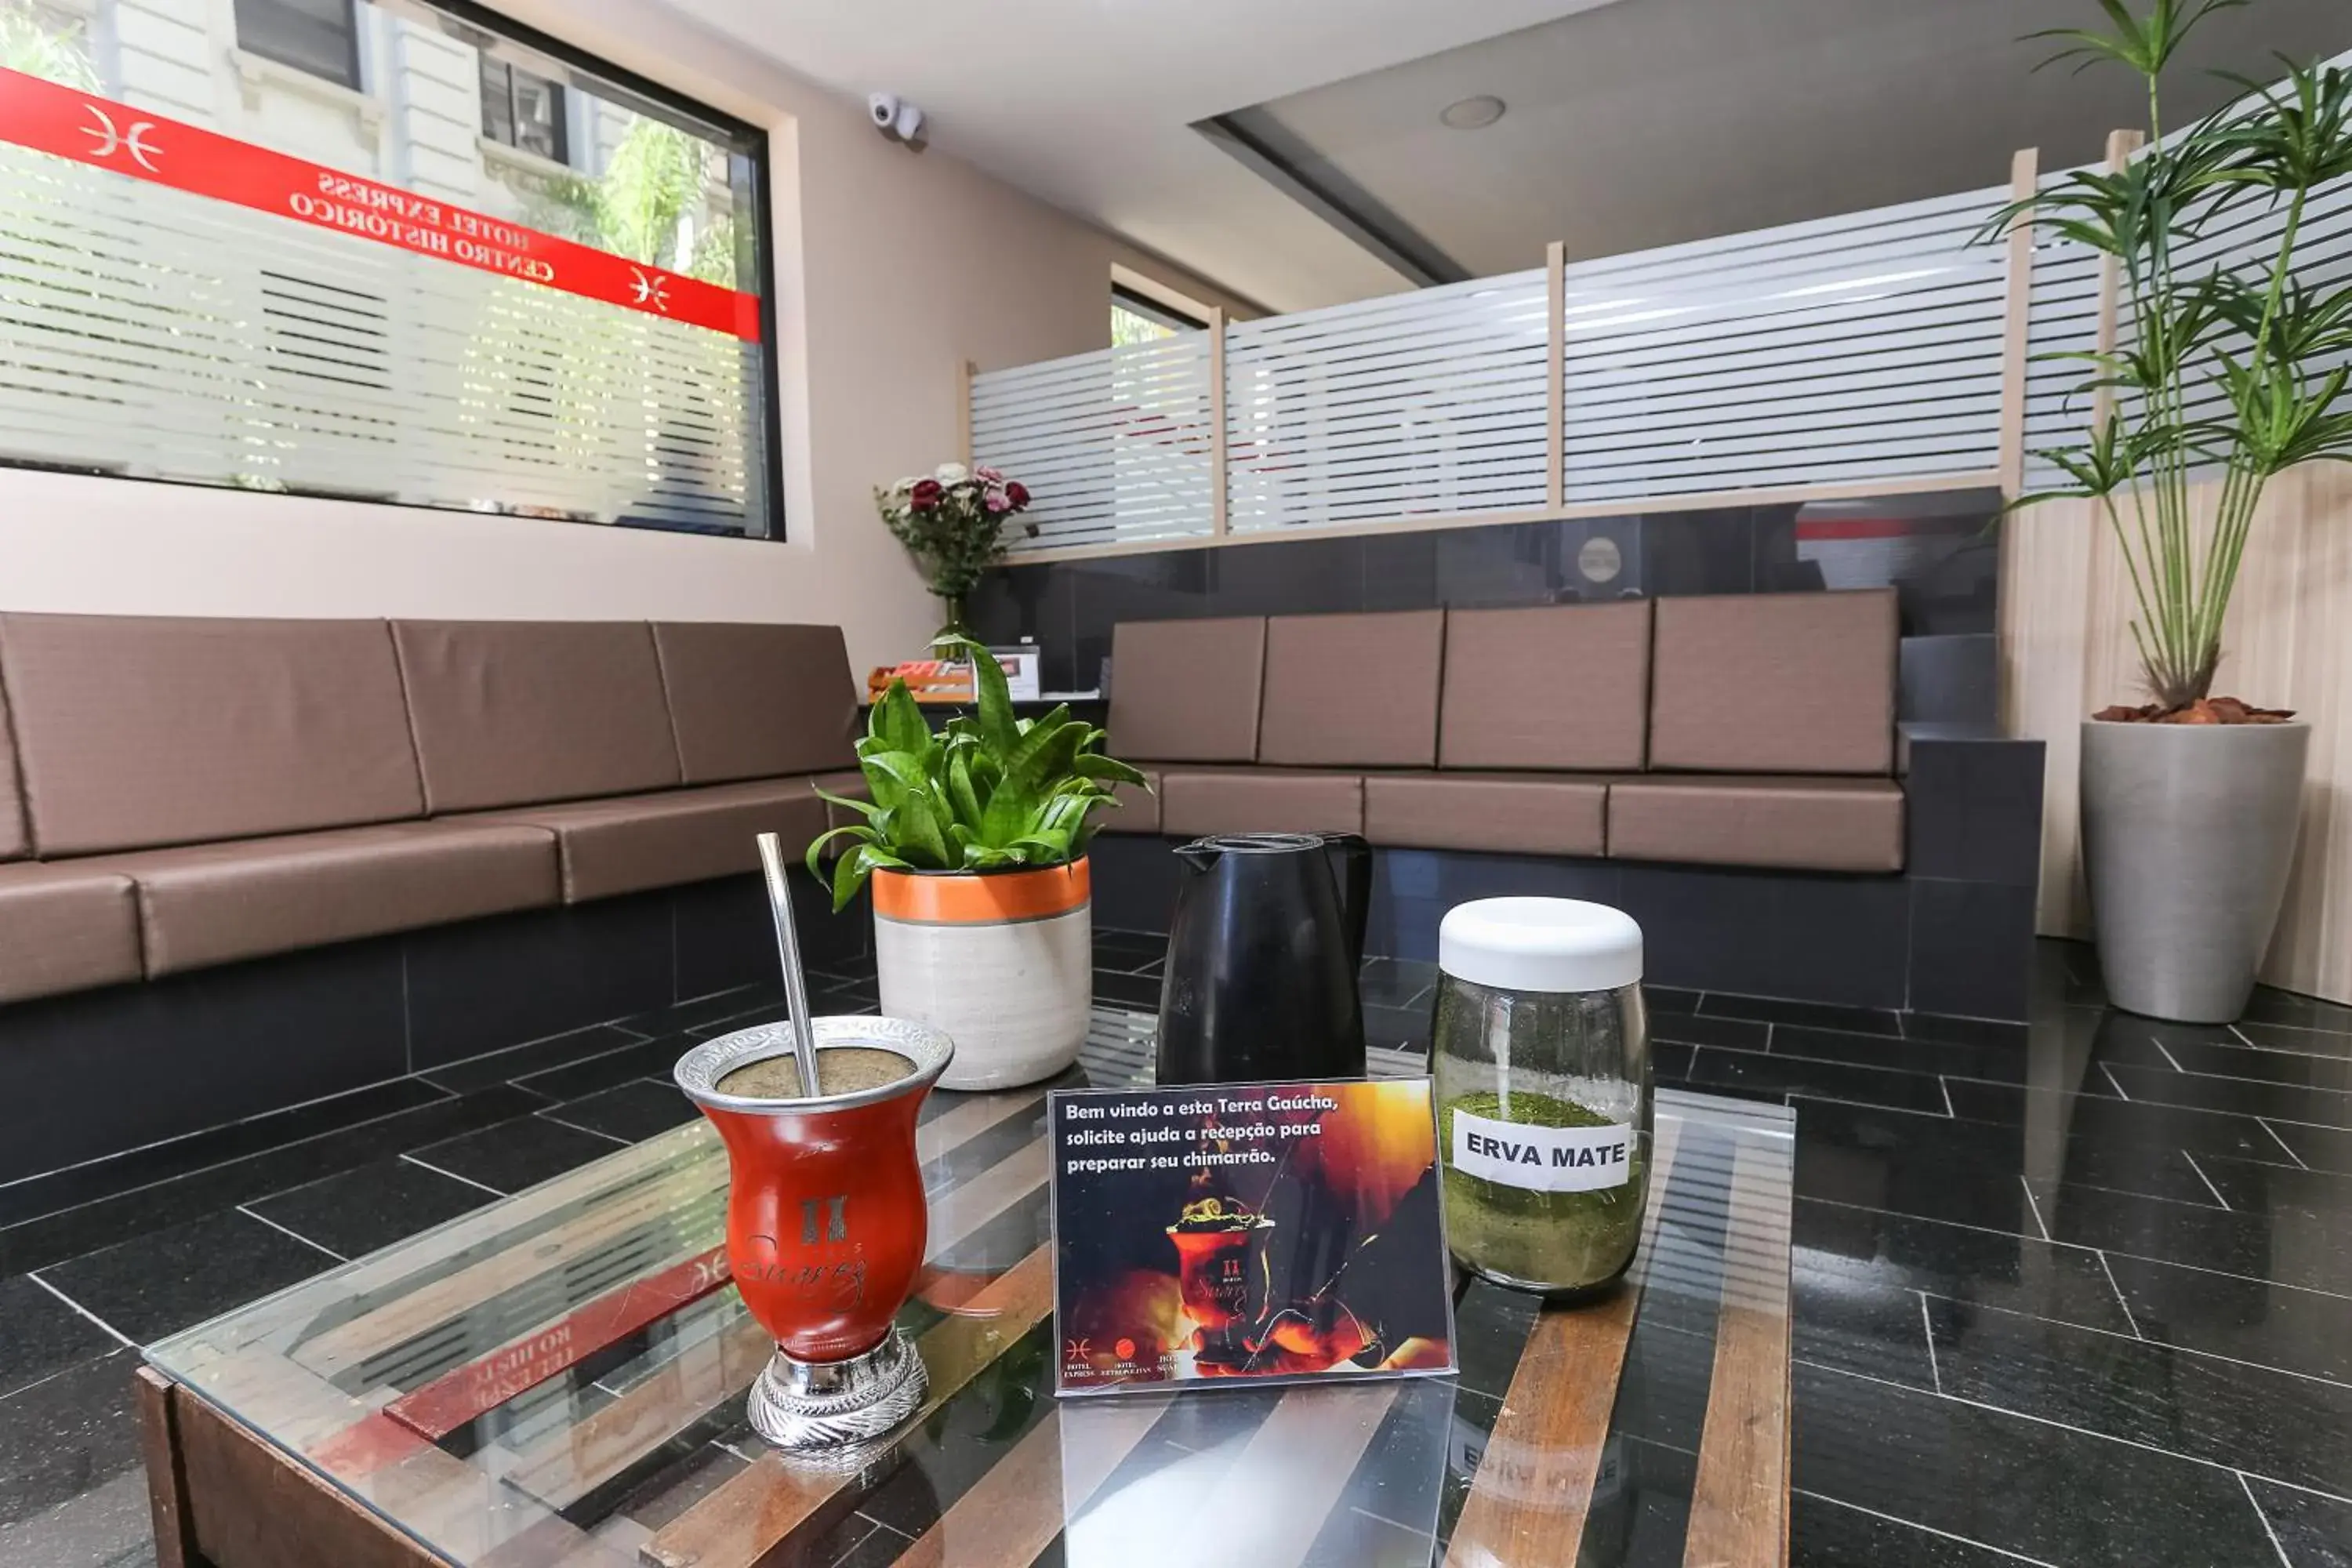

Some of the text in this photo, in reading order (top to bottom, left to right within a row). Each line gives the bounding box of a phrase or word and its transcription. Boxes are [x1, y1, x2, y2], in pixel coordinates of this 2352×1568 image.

[1066, 1095, 1338, 1120] Bem vindo a esta Terra Gaúcha,
[1066, 1122, 1321, 1146] solicite ajuda a recepção para
[1067, 1149, 1276, 1175] preparar seu chimarrão.
[1466, 1131, 1625, 1168] ERVA MATE
[1064, 1370, 1095, 1378] EXPRESS
